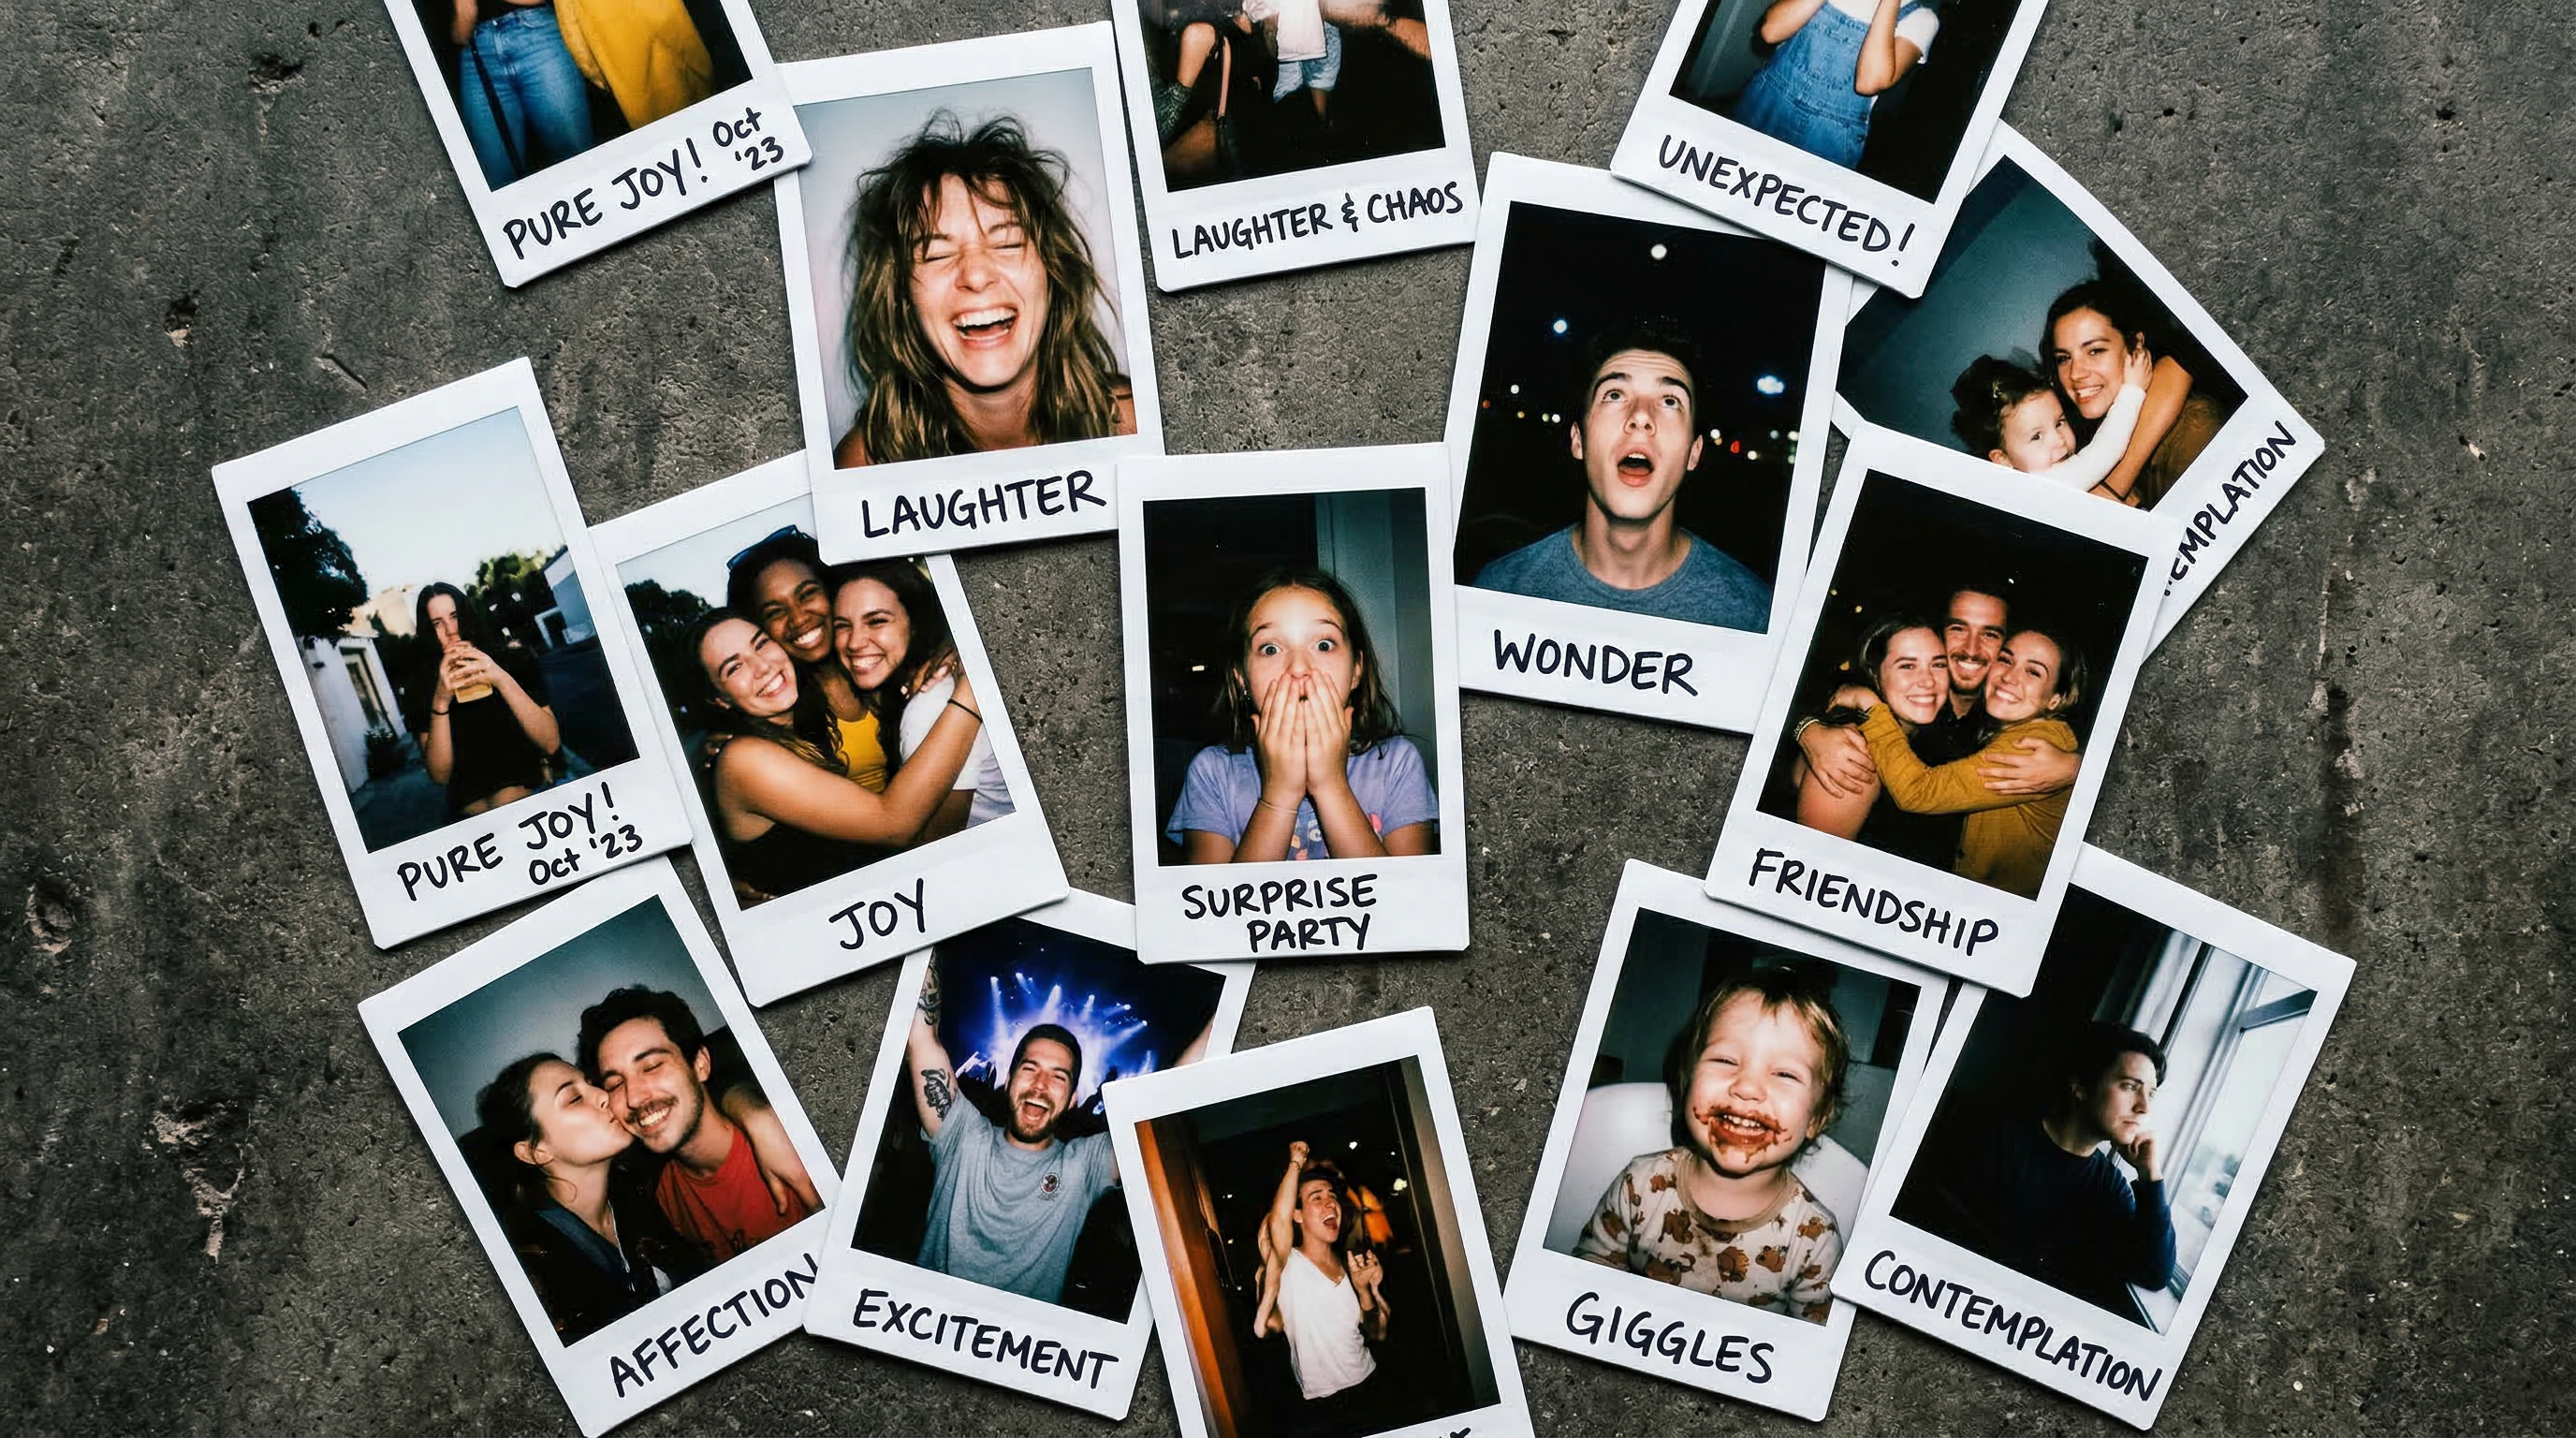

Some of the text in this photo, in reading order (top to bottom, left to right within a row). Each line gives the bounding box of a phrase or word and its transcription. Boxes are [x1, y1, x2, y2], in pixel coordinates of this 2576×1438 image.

[712, 107, 762, 148] Oct
[734, 136, 784, 171] '23
[502, 137, 709, 260] PURE JOY!
[1171, 181, 1463, 259] LAUGHTER & CHAOS
[1659, 134, 1916, 267] UNEXPECTED!
[861, 469, 1107, 538] LAUGHTER
[1493, 628, 1699, 697] WONDER
[396, 781, 620, 902] PURE JOY!
[528, 824, 643, 886] Oct '23
[828, 877, 926, 950] JOY
[1181, 873, 1378, 920] SURPRISE
[1248, 912, 1372, 953] PARTY
[1749, 847, 1999, 957] FRIENDSHIP
[609, 1253, 819, 1399] AFFECTION
[852, 1288, 1120, 1390] EXCITEMENT
[1566, 1292, 1775, 1385] GIGGLES
[1865, 1251, 2163, 1401] CONTEMPLATION
